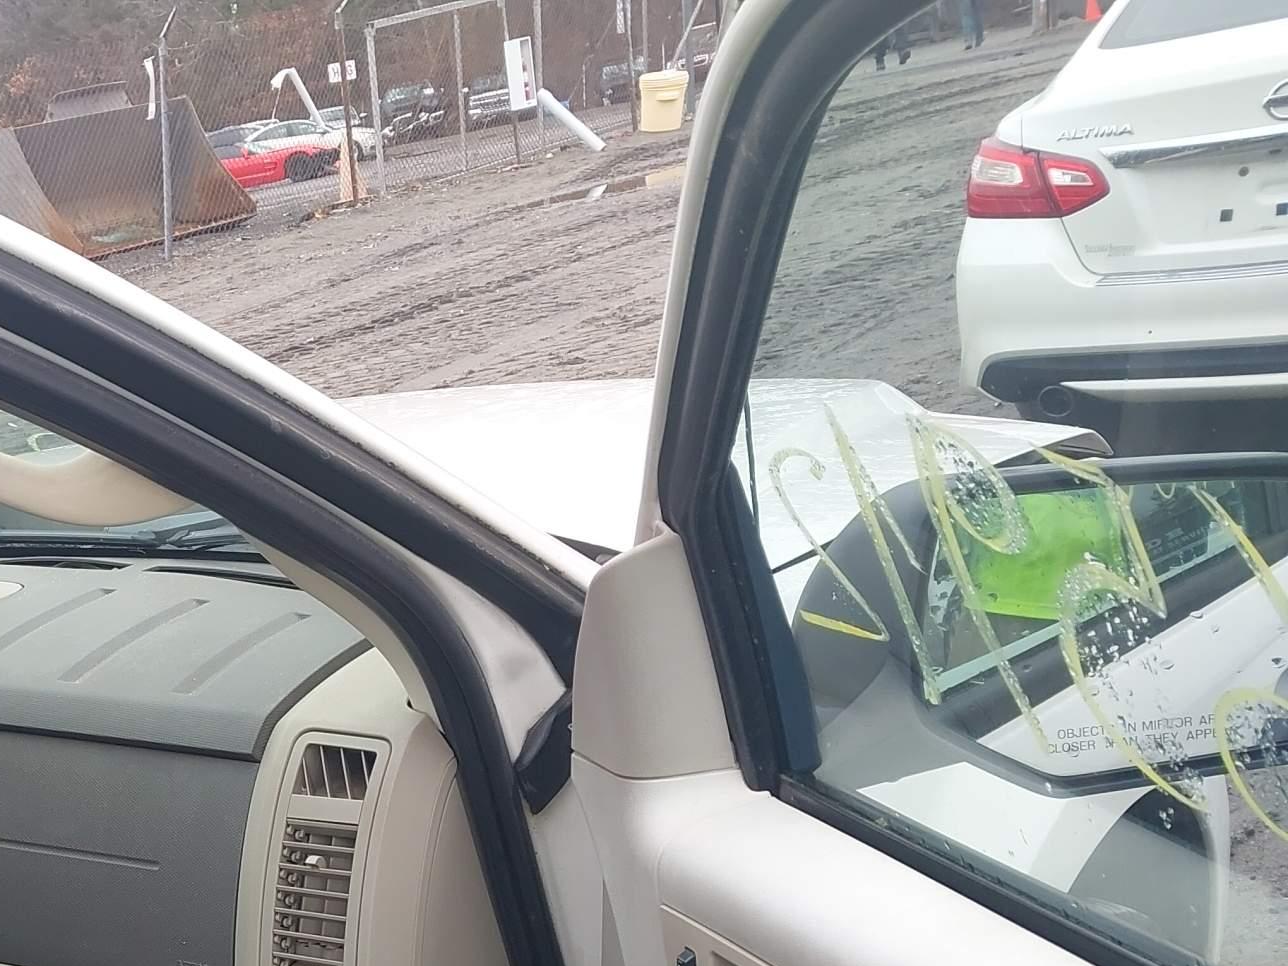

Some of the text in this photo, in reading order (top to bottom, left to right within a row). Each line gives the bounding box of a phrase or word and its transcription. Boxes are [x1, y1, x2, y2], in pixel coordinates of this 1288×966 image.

[1057, 123, 1134, 141] ALTIMA
[1057, 724, 1112, 740] OBJECT
[1048, 739, 1096, 754] CLOSER
